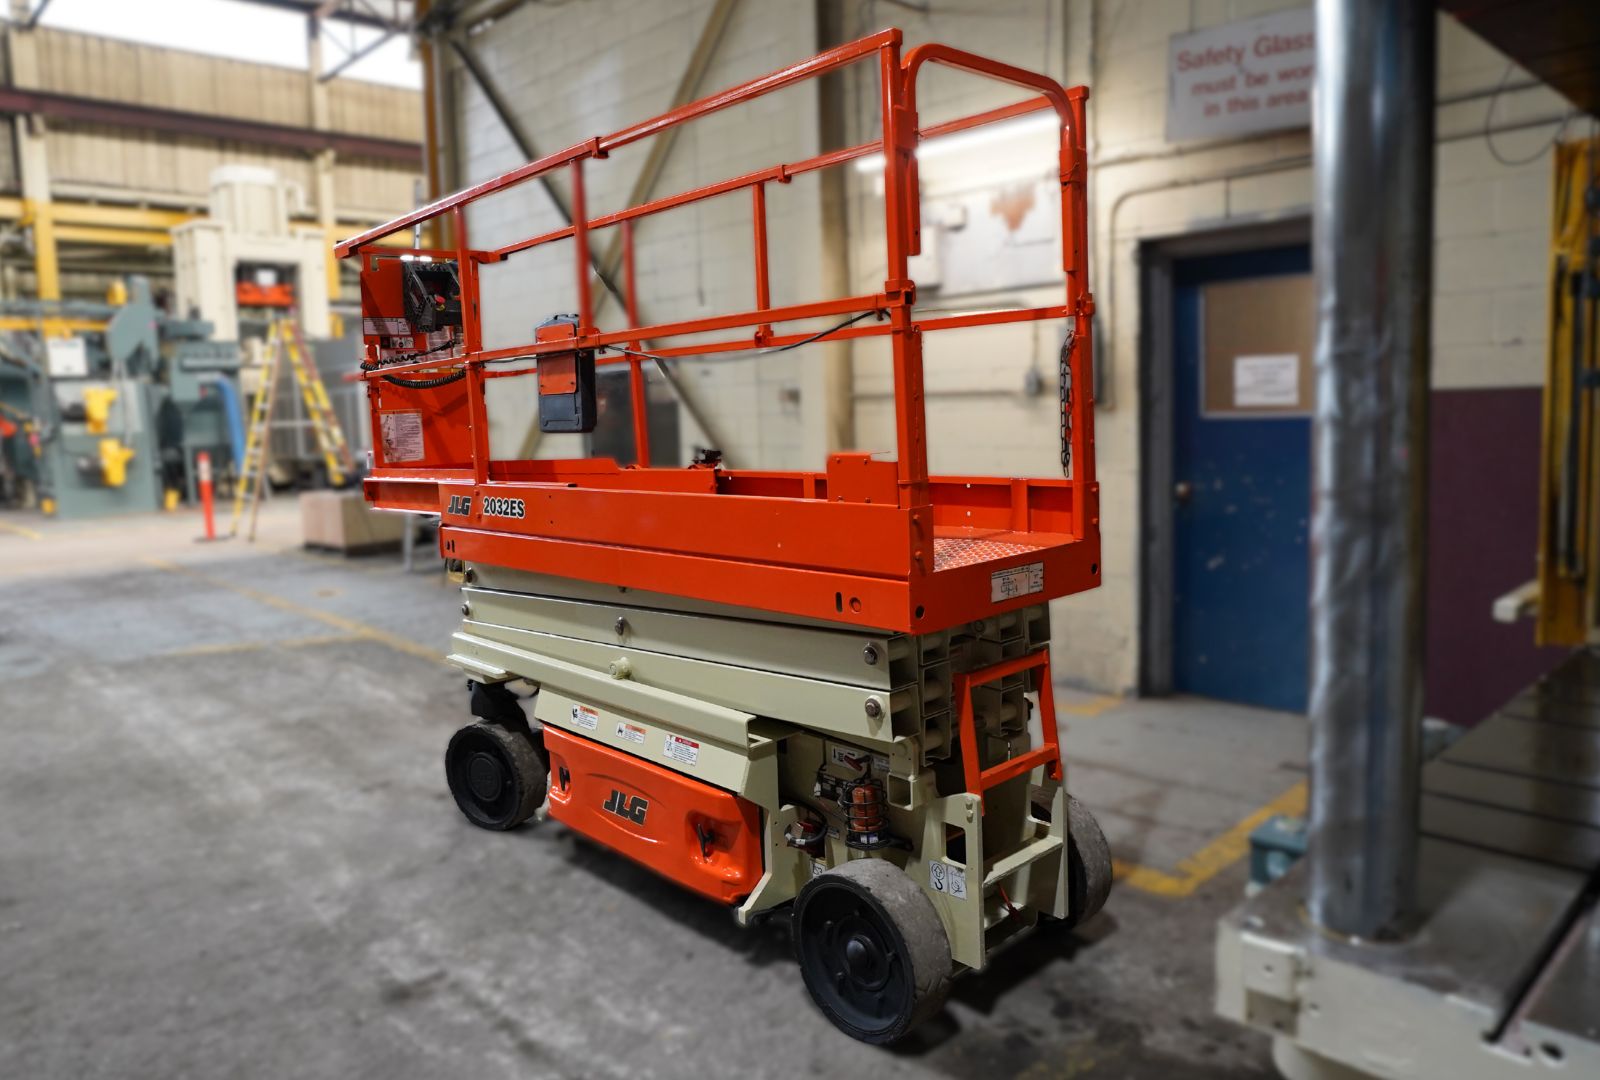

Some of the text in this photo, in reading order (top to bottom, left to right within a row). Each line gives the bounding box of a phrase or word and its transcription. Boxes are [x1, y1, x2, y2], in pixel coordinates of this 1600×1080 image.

[1177, 44, 1244, 72] Safety
[1192, 75, 1237, 95] must
[1245, 71, 1269, 87] be
[1203, 89, 1309, 118] in this area
[447, 495, 525, 519] JLG 2032ES
[603, 790, 649, 826] JLG
